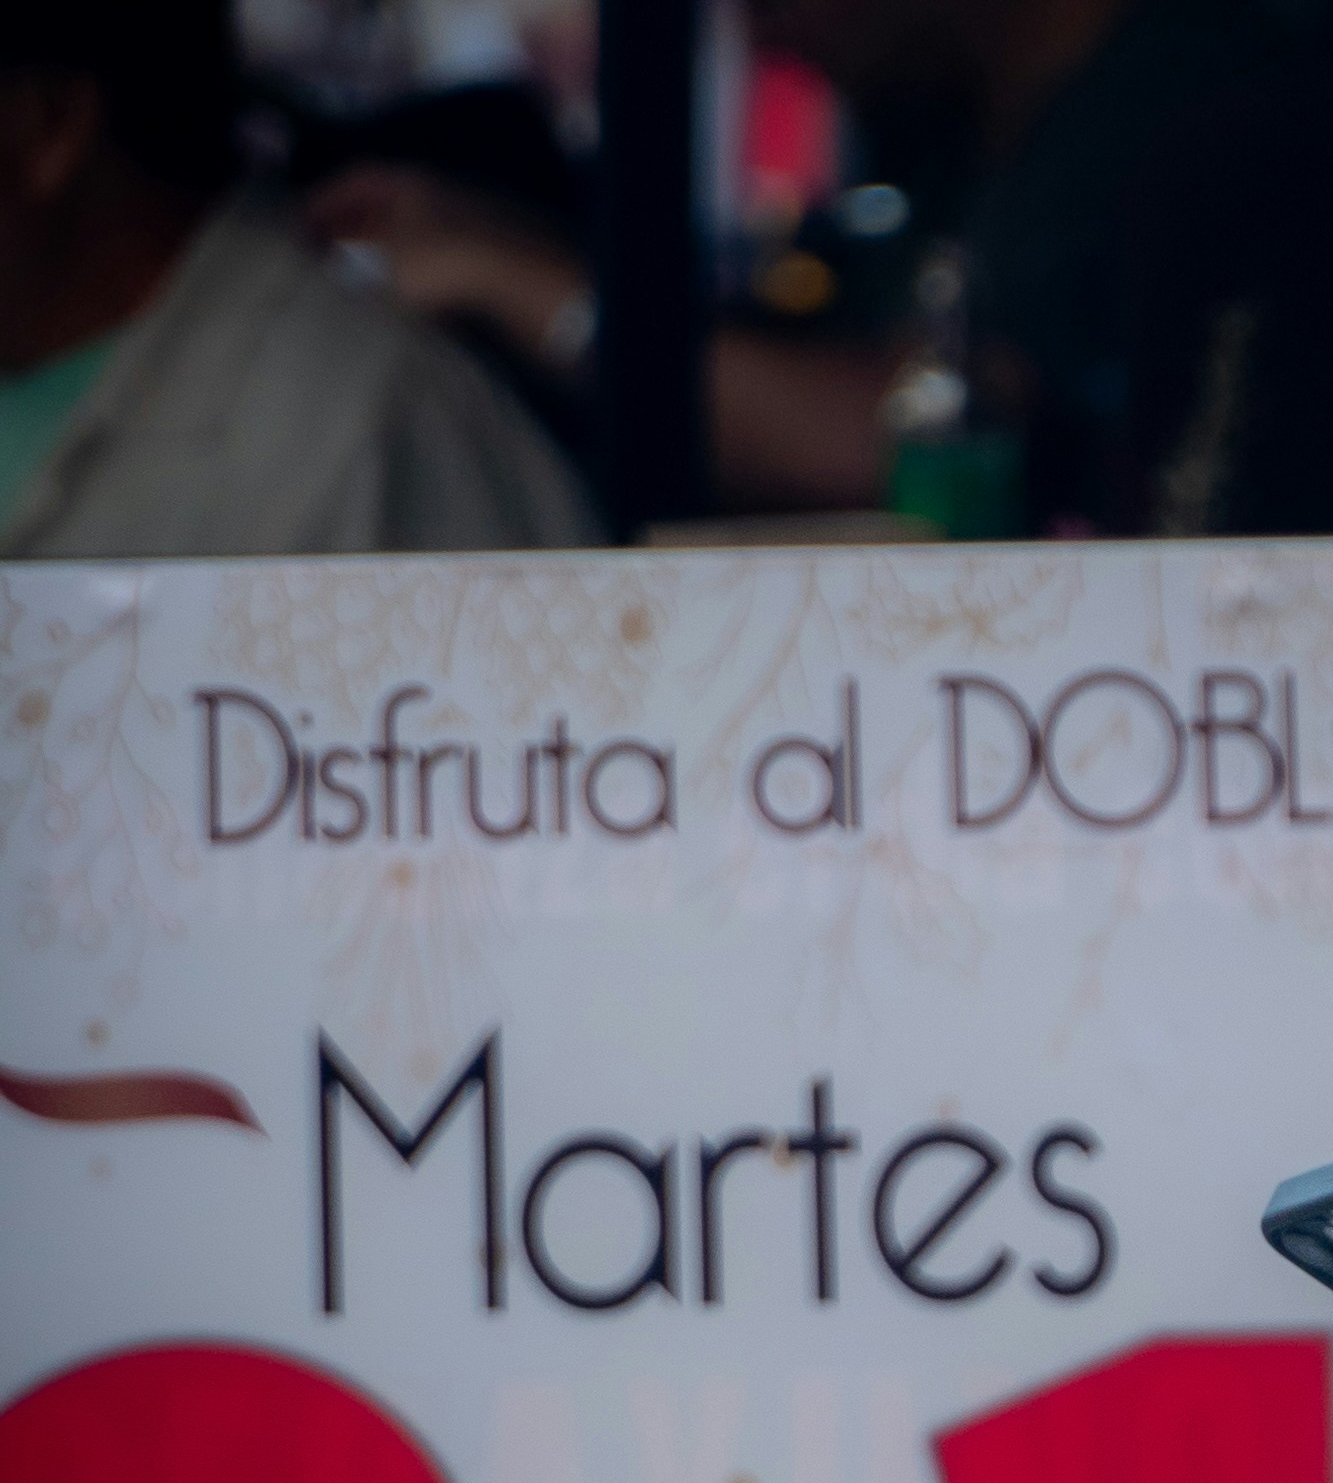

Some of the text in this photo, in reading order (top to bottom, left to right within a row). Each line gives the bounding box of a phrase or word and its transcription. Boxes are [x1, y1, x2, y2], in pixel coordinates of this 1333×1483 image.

[190, 685, 676, 848] Disfruta
[749, 679, 862, 837] al
[308, 1026, 1119, 1323] Martes
